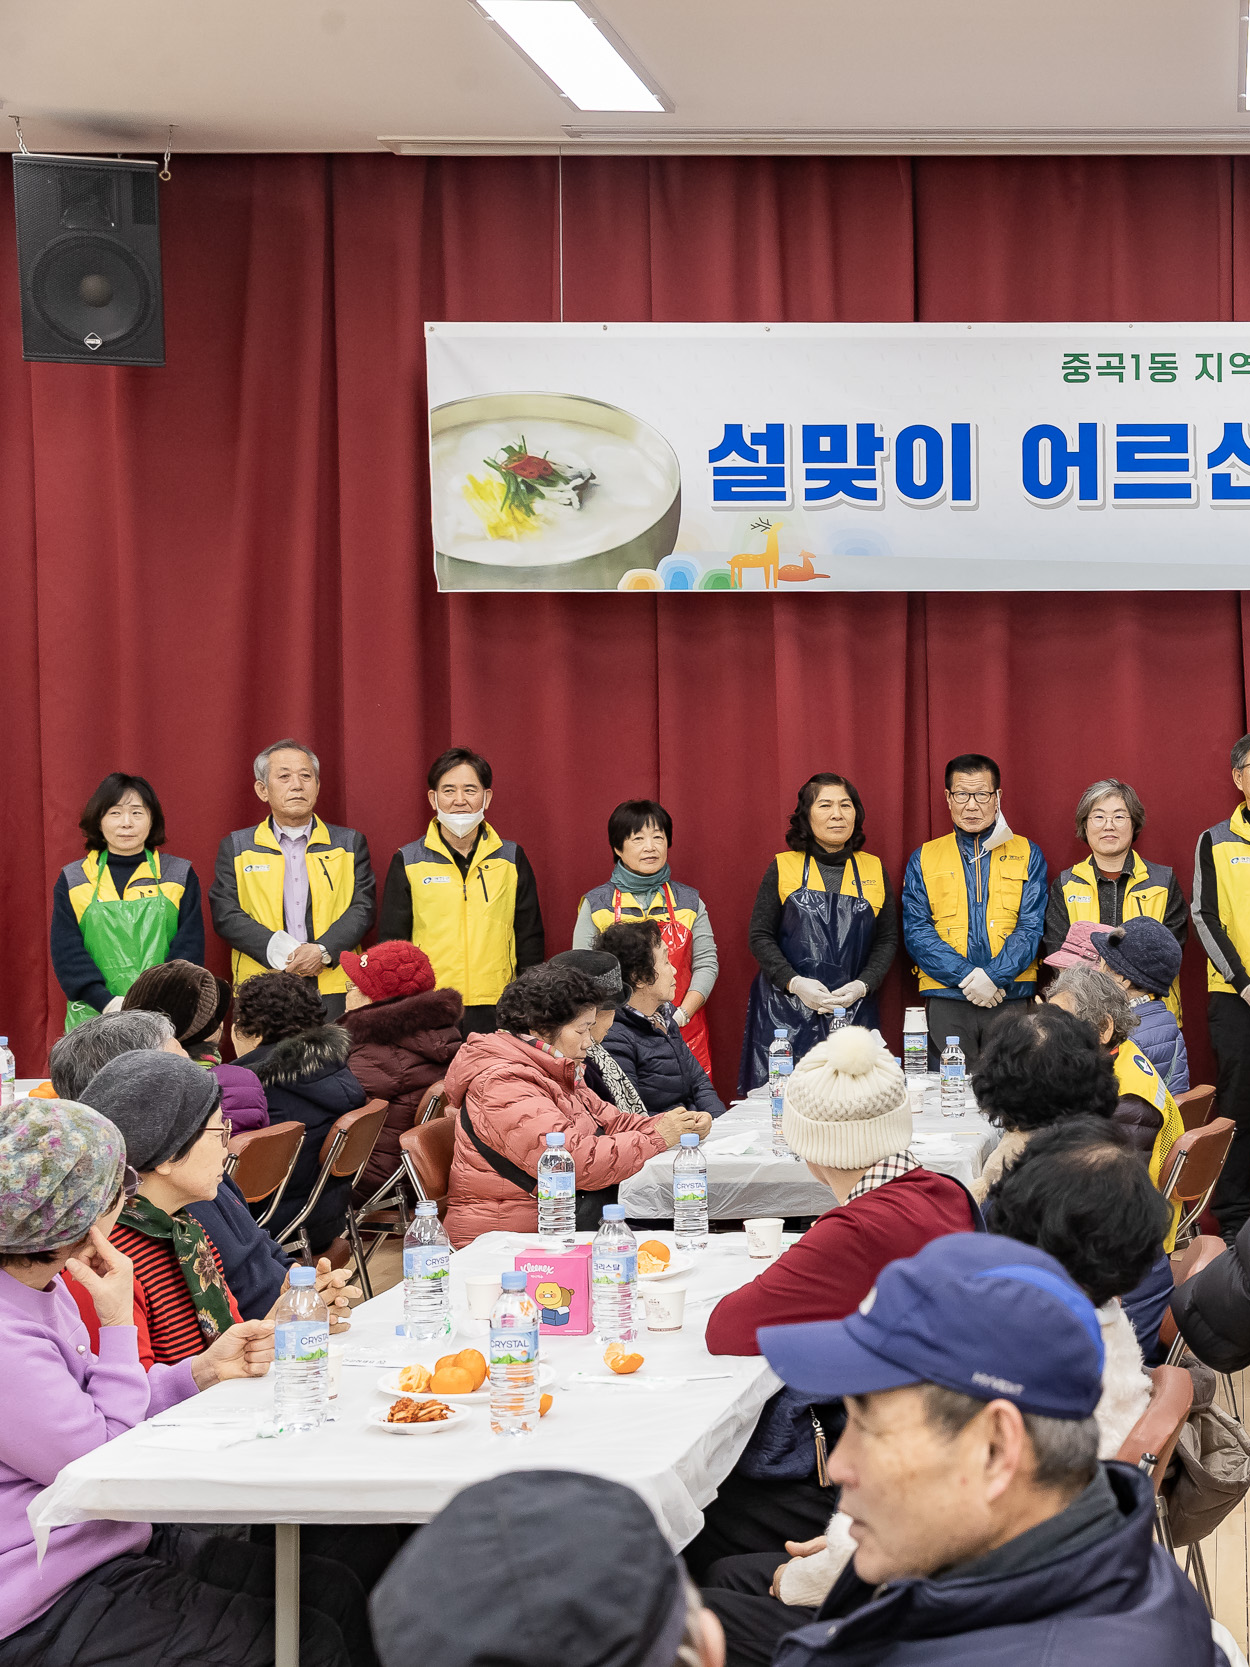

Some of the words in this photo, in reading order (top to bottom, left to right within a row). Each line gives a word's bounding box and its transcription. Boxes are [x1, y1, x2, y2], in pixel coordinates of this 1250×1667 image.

[1061, 352, 1179, 384] 중곡1동
[707, 422, 974, 504] 설맞이
[676, 1181, 706, 1190] CRYSTAL
[519, 1261, 555, 1276] Kleenex
[490, 1338, 530, 1349] CRYSTAL
